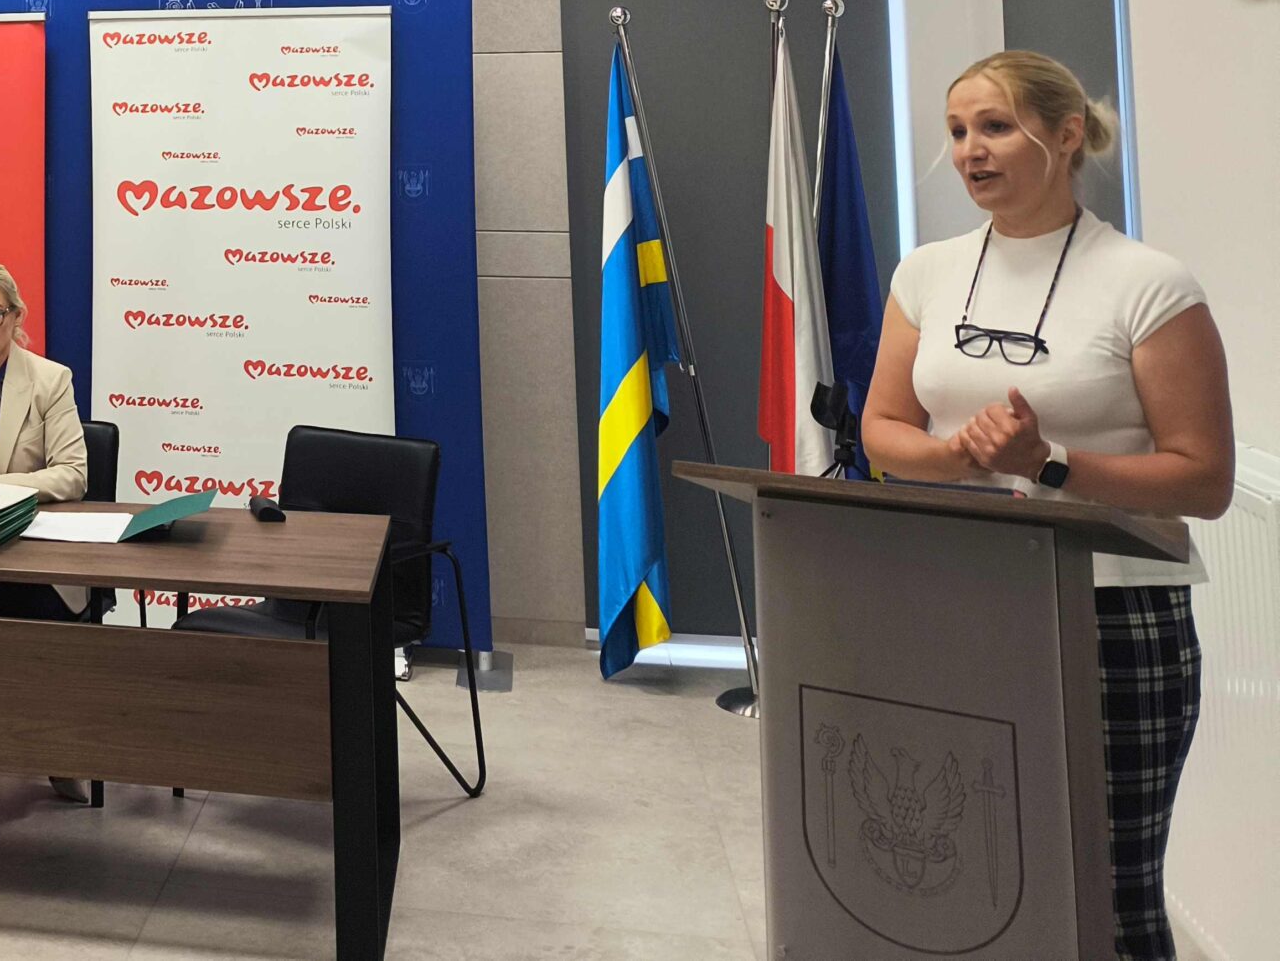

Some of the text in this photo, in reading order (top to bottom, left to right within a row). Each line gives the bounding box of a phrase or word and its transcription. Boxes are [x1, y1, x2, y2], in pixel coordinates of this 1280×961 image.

[102, 31, 212, 49] Mazowsze.
[249, 72, 375, 92] Mazowsze.
[112, 101, 205, 116] Mazowsze.
[116, 179, 361, 217] Mazowsze.
[278, 217, 352, 230] serce Polski
[224, 248, 335, 266] Mazowsze.
[124, 310, 249, 330] Mazowsze.
[243, 359, 374, 382] Mazowsze.
[108, 393, 204, 410] Mazowsze.
[134, 470, 282, 499] Mazowsz
